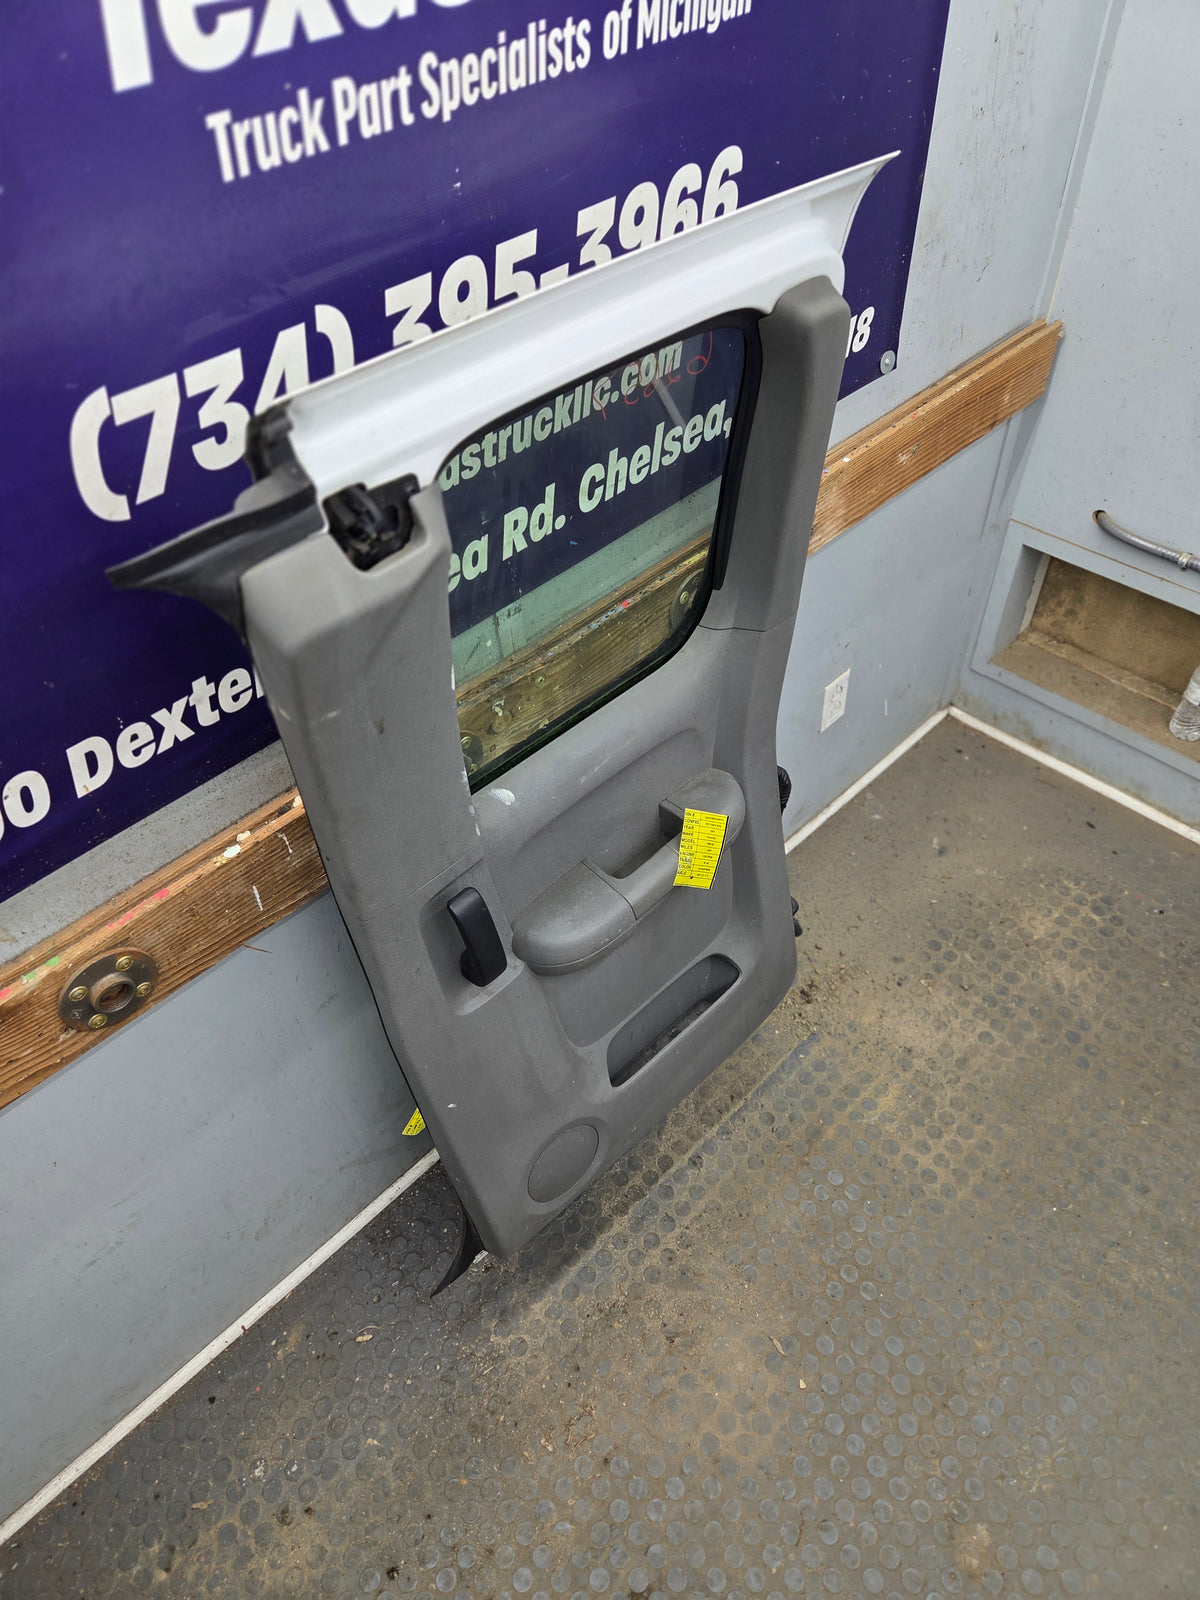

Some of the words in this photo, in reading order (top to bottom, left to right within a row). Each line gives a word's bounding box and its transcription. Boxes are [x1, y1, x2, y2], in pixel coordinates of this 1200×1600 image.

[204, 87, 331, 183] Truck
[332, 65, 415, 147] Part
[418, 16, 592, 123] Specialists
[602, 0, 632, 60] of
[69, 303, 355, 522] (734)
[384, 145, 744, 348] 395-3966
[439, 340, 683, 492] astruckllc.com
[502, 482, 566, 561] Rd.
[578, 398, 733, 514] Chelsea,
